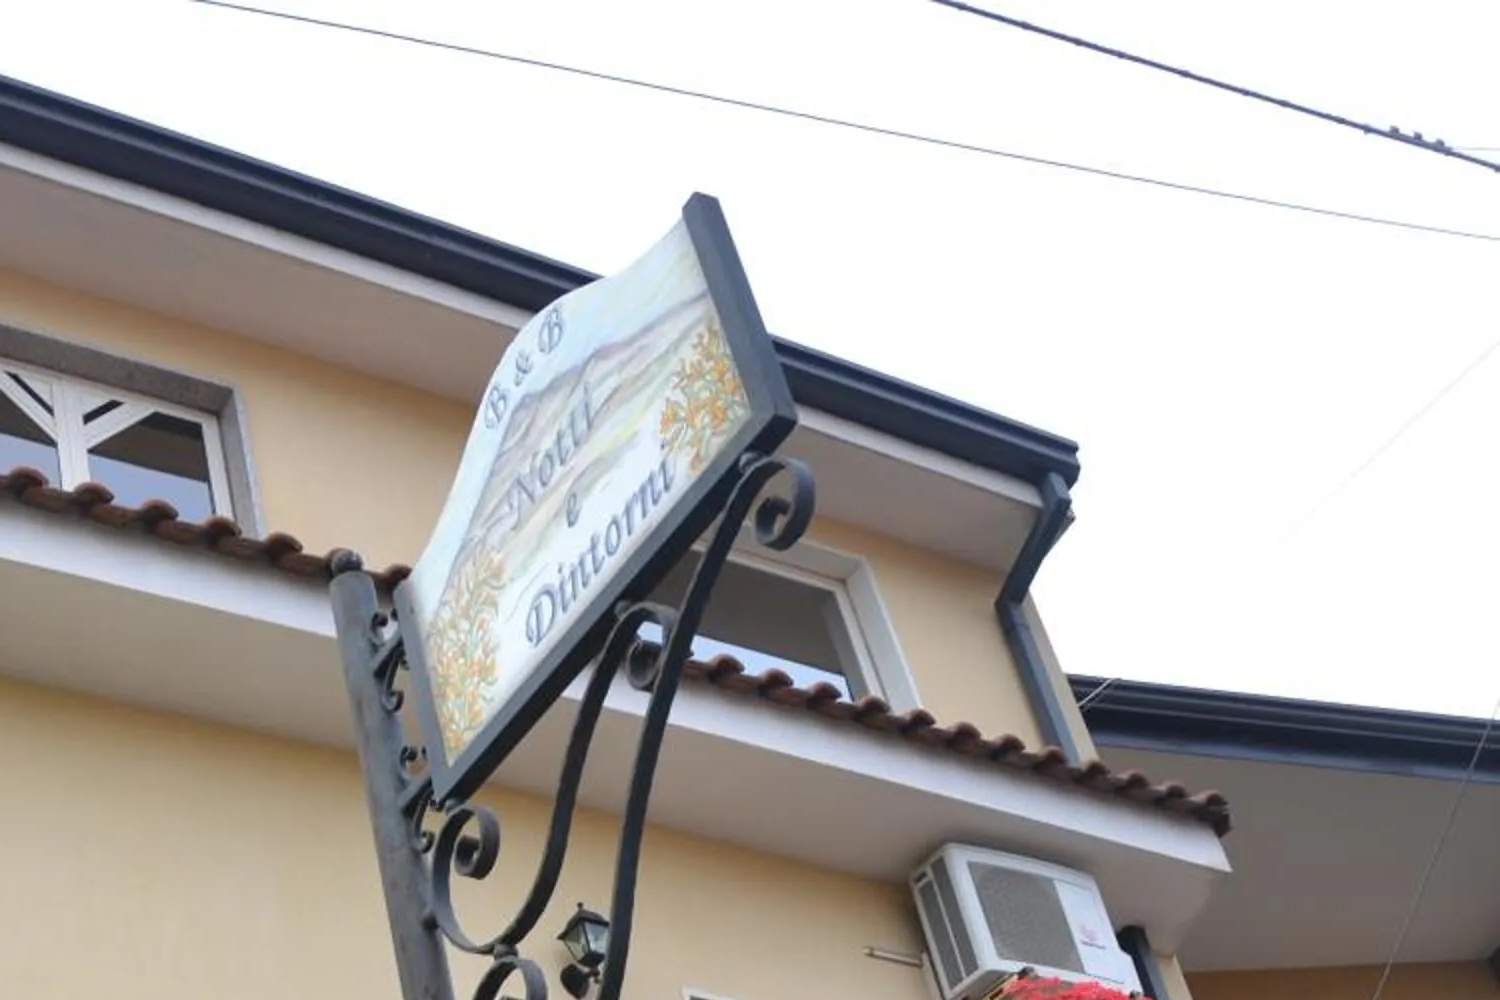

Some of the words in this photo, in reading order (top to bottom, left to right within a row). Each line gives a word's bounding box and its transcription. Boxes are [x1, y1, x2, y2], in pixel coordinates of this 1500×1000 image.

[484, 385, 508, 430] B
[514, 350, 533, 387] &
[537, 307, 564, 355] B
[505, 380, 593, 531] Notti
[566, 491, 583, 528] e
[525, 441, 677, 648] Dintorni
